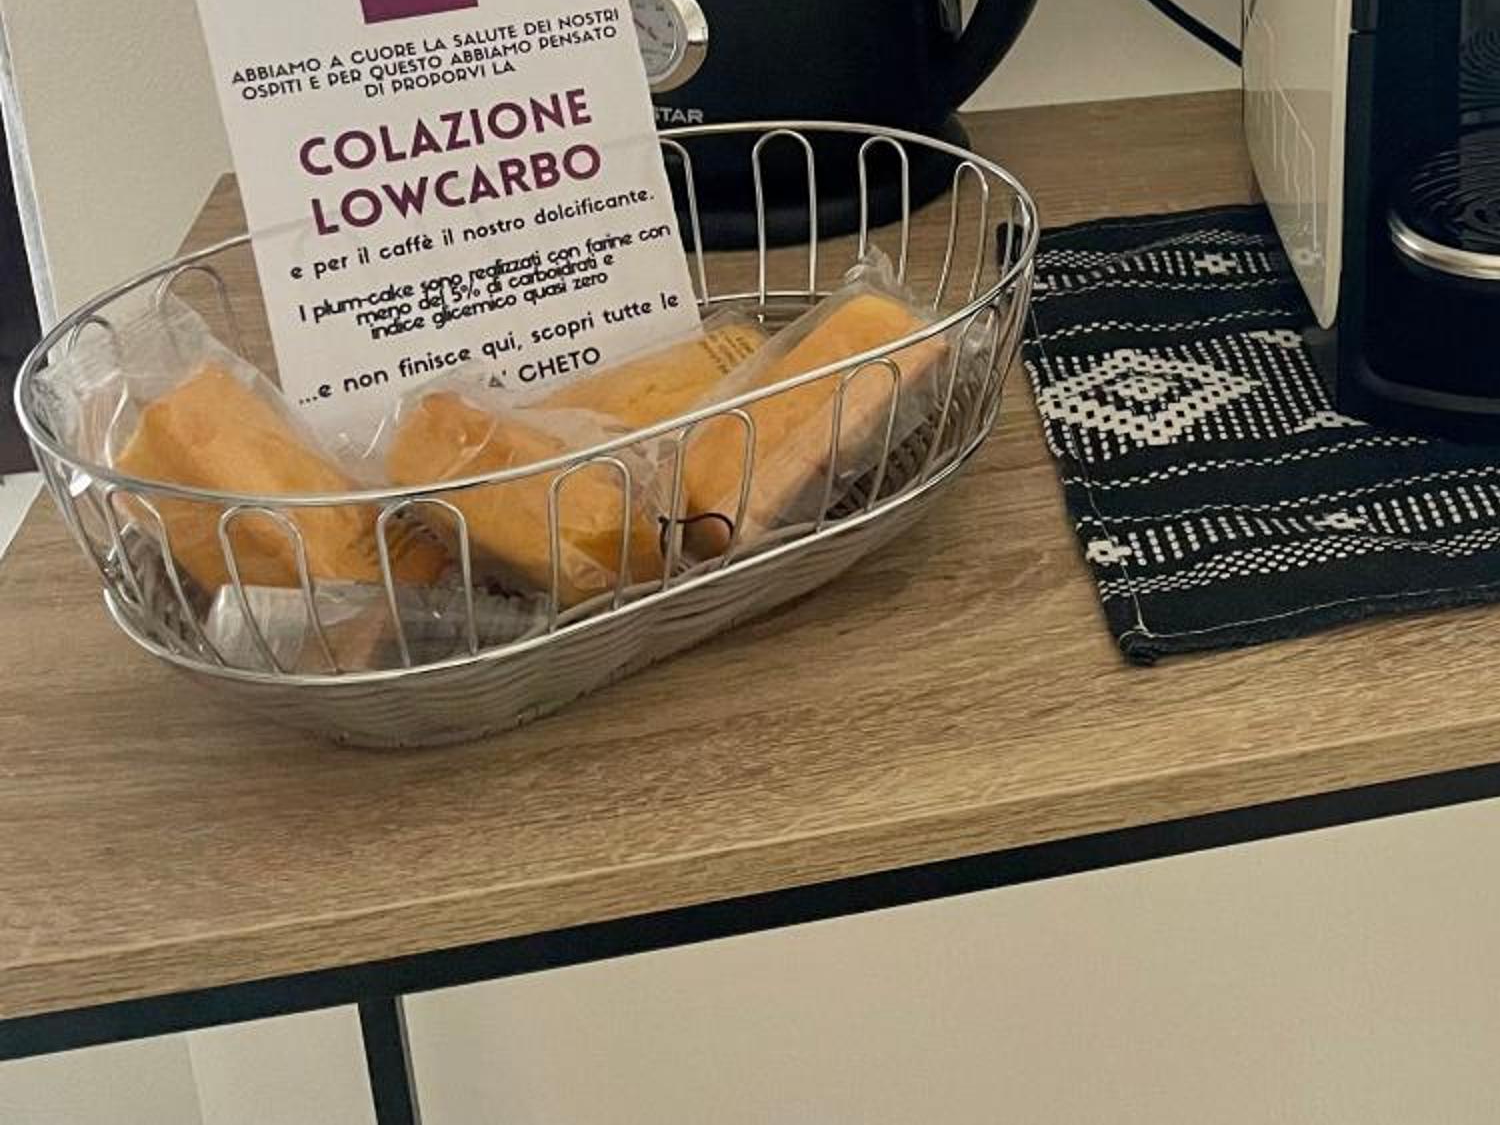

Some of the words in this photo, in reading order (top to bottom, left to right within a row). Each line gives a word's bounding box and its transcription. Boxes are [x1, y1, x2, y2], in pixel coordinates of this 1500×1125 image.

[232, 58, 321, 84] ABBIAMO
[331, 55, 344, 68] A
[351, 43, 416, 64] CUORE
[423, 39, 448, 53] LA
[453, 25, 518, 47] SALUTE
[524, 19, 550, 36] DEI
[558, 8, 619, 30] NOSTRI
[242, 79, 302, 100] OSPITI
[310, 76, 320, 90] E
[328, 69, 361, 86] PER
[369, 56, 442, 81] QUESTO
[451, 40, 531, 65] ABBIAMO
[539, 26, 617, 49] PENSATO
[365, 83, 385, 97] DI
[392, 64, 486, 94] PROPORVI
[492, 60, 516, 75] LA
[299, 88, 592, 175] COLAZIONE
[311, 144, 601, 236] LOWCARBO
[290, 266, 303, 279] e
[313, 256, 348, 279] per
[357, 246, 370, 264] il
[379, 234, 433, 259] caffè
[441, 228, 454, 245] il
[463, 218, 525, 241] nostro
[534, 189, 654, 225] dolcificante.
[299, 305, 307, 322] I
[313, 284, 414, 324] plum-cake
[420, 274, 462, 292] sono
[469, 251, 541, 282] realizzati
[547, 245, 580, 263] con
[586, 233, 632, 254] farine
[639, 224, 670, 241] con
[356, 303, 412, 326] meno
[419, 287, 445, 310] del
[450, 281, 480, 302] 5%
[486, 277, 502, 294] di
[509, 254, 597, 288] carboidrati
[604, 253, 615, 265] e
[371, 317, 425, 339] indice
[432, 295, 517, 330] glicemico
[523, 279, 567, 305] quasi
[572, 273, 608, 290] zero
[300, 384, 332, 405] ...e
[343, 370, 388, 393] non
[398, 348, 471, 377] finisce
[482, 331, 522, 359] qui,
[531, 312, 594, 343] scopri
[602, 302, 652, 324] tutte
[660, 292, 680, 310] le
[518, 347, 600, 382] CHETO
